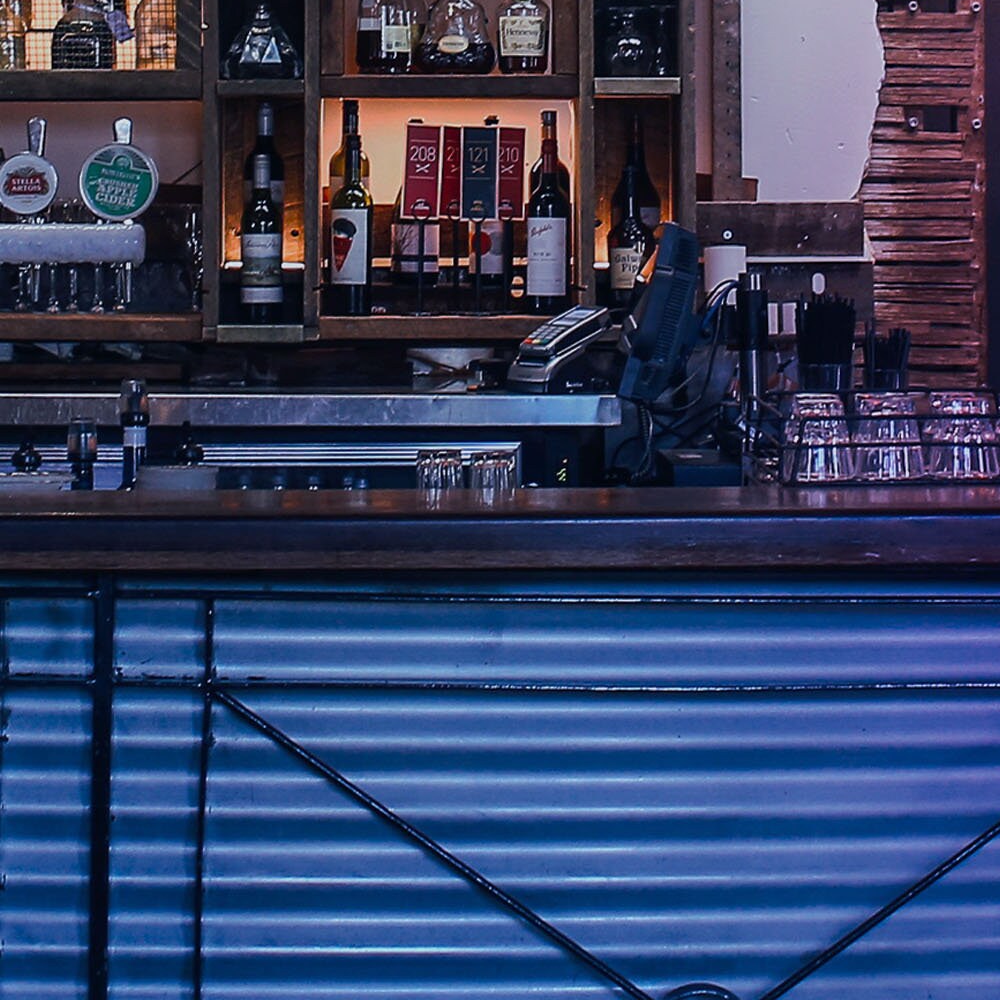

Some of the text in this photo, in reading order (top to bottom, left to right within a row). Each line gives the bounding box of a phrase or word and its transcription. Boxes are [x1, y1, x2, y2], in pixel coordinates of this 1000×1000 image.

[410, 145, 437, 162] 208
[468, 147, 489, 162] 121
[95, 192, 136, 207] CIDER
